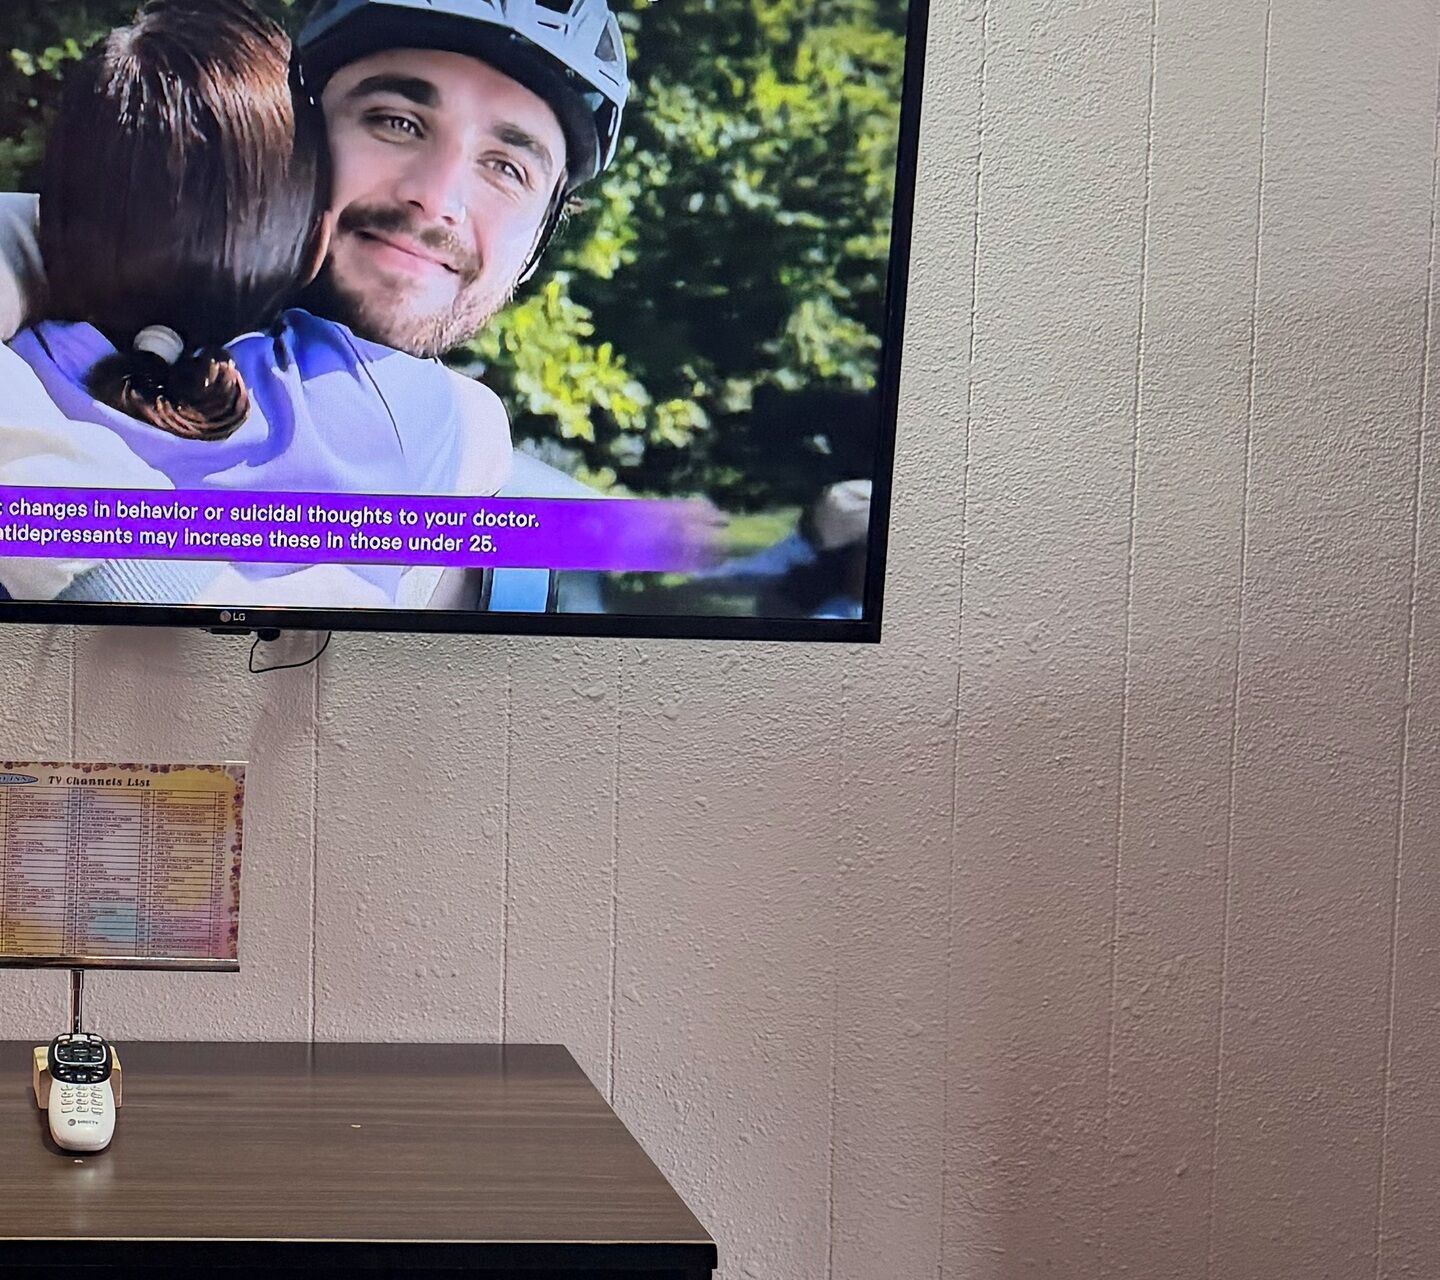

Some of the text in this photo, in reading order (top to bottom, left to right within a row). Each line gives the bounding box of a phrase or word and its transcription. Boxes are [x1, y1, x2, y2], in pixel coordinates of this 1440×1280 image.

[8, 497, 88, 521] changes
[93, 499, 110, 518] in
[116, 499, 198, 520] behavior
[204, 505, 224, 521] or
[229, 504, 301, 522] suicidal
[307, 505, 393, 528] thoughts
[398, 508, 418, 526] to
[424, 510, 467, 530] your
[472, 508, 540, 528] doctor.
[139, 529, 178, 549] may
[184, 527, 263, 548] increase
[268, 530, 320, 549] these
[326, 530, 343, 549] in
[349, 531, 402, 551] those
[408, 533, 463, 552] under
[469, 534, 498, 553] 25.
[233, 613, 246, 621] LG
[48, 775, 151, 787] TV Channels List
